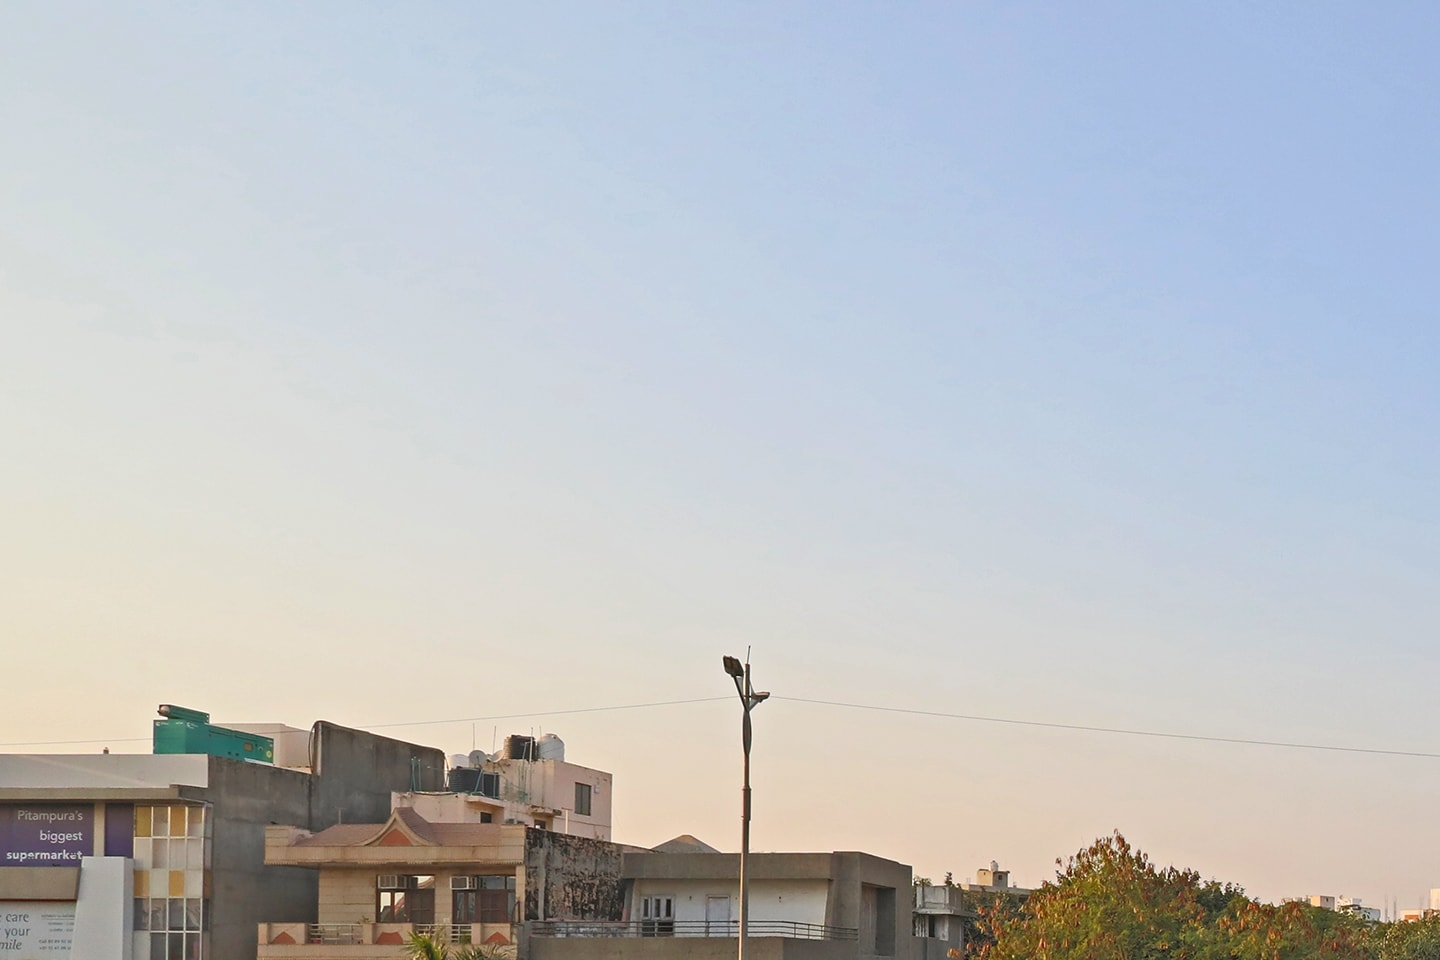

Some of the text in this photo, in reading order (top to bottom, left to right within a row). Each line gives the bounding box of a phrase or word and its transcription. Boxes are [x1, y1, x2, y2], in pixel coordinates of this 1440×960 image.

[17, 809, 84, 824] Pitampura's
[40, 830, 83, 844] biggest
[6, 849, 83, 862] supermarket
[5, 913, 30, 923] care
[4, 927, 31, 939] your
